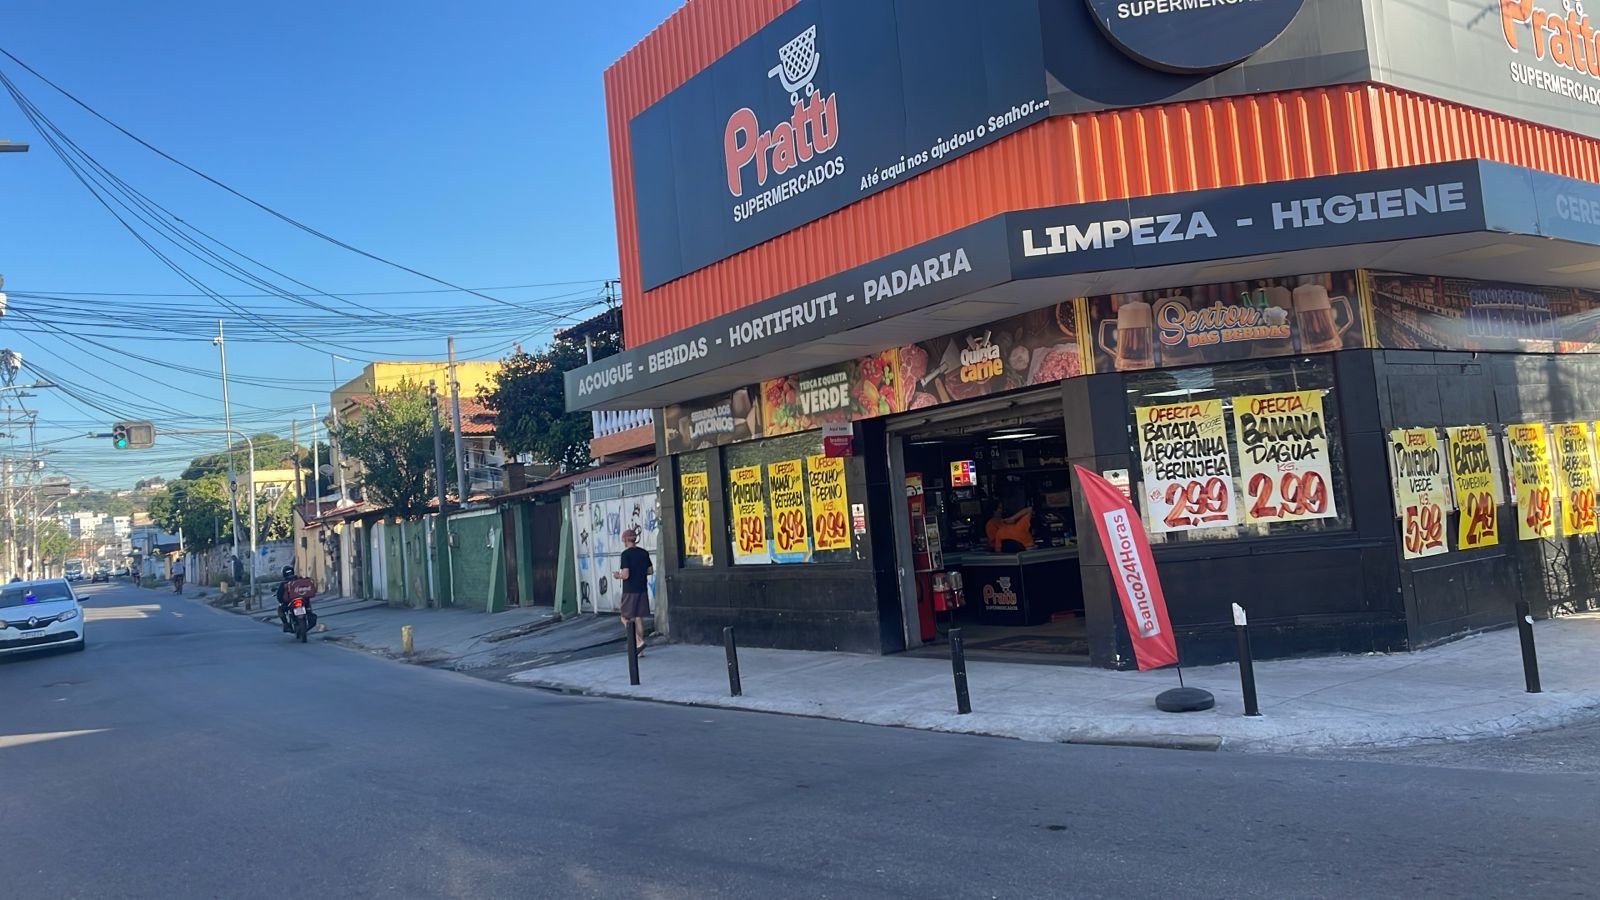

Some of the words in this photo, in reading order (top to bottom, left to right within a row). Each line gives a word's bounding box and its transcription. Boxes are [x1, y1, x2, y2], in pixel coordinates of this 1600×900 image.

[860, 168, 879, 191] Até
[881, 155, 906, 179] aqui
[907, 150, 929, 170] nos
[931, 129, 975, 158] ajudou
[976, 124, 986, 137] o
[988, 100, 1050, 132] Senhor...
[733, 156, 846, 222] SUPERMERCADOS
[1022, 210, 1218, 257] LIMPEZA
[1272, 181, 1467, 231] HIGIENE
[578, 362, 634, 396] AÇOUGUE
[648, 336, 709, 374] BEBIDAS
[729, 292, 839, 348] HORTIFRUTI
[863, 247, 972, 304] PADARIA
[1158, 301, 1259, 346] Sextou
[1187, 331, 1220, 348] DAS
[1221, 325, 1290, 343] BEBIDAS
[960, 358, 1003, 383] carne
[800, 383, 850, 415] VERDE
[1142, 421, 1199, 442] BATATA
[1240, 411, 1325, 446] BANANA
[1143, 436, 1227, 462] ABOBRINHA
[1453, 442, 1491, 475] BATATA
[1155, 457, 1230, 480] BERINJELA
[1410, 478, 1433, 493] VERDE
[1113, 514, 1154, 632] Banco24Horas
